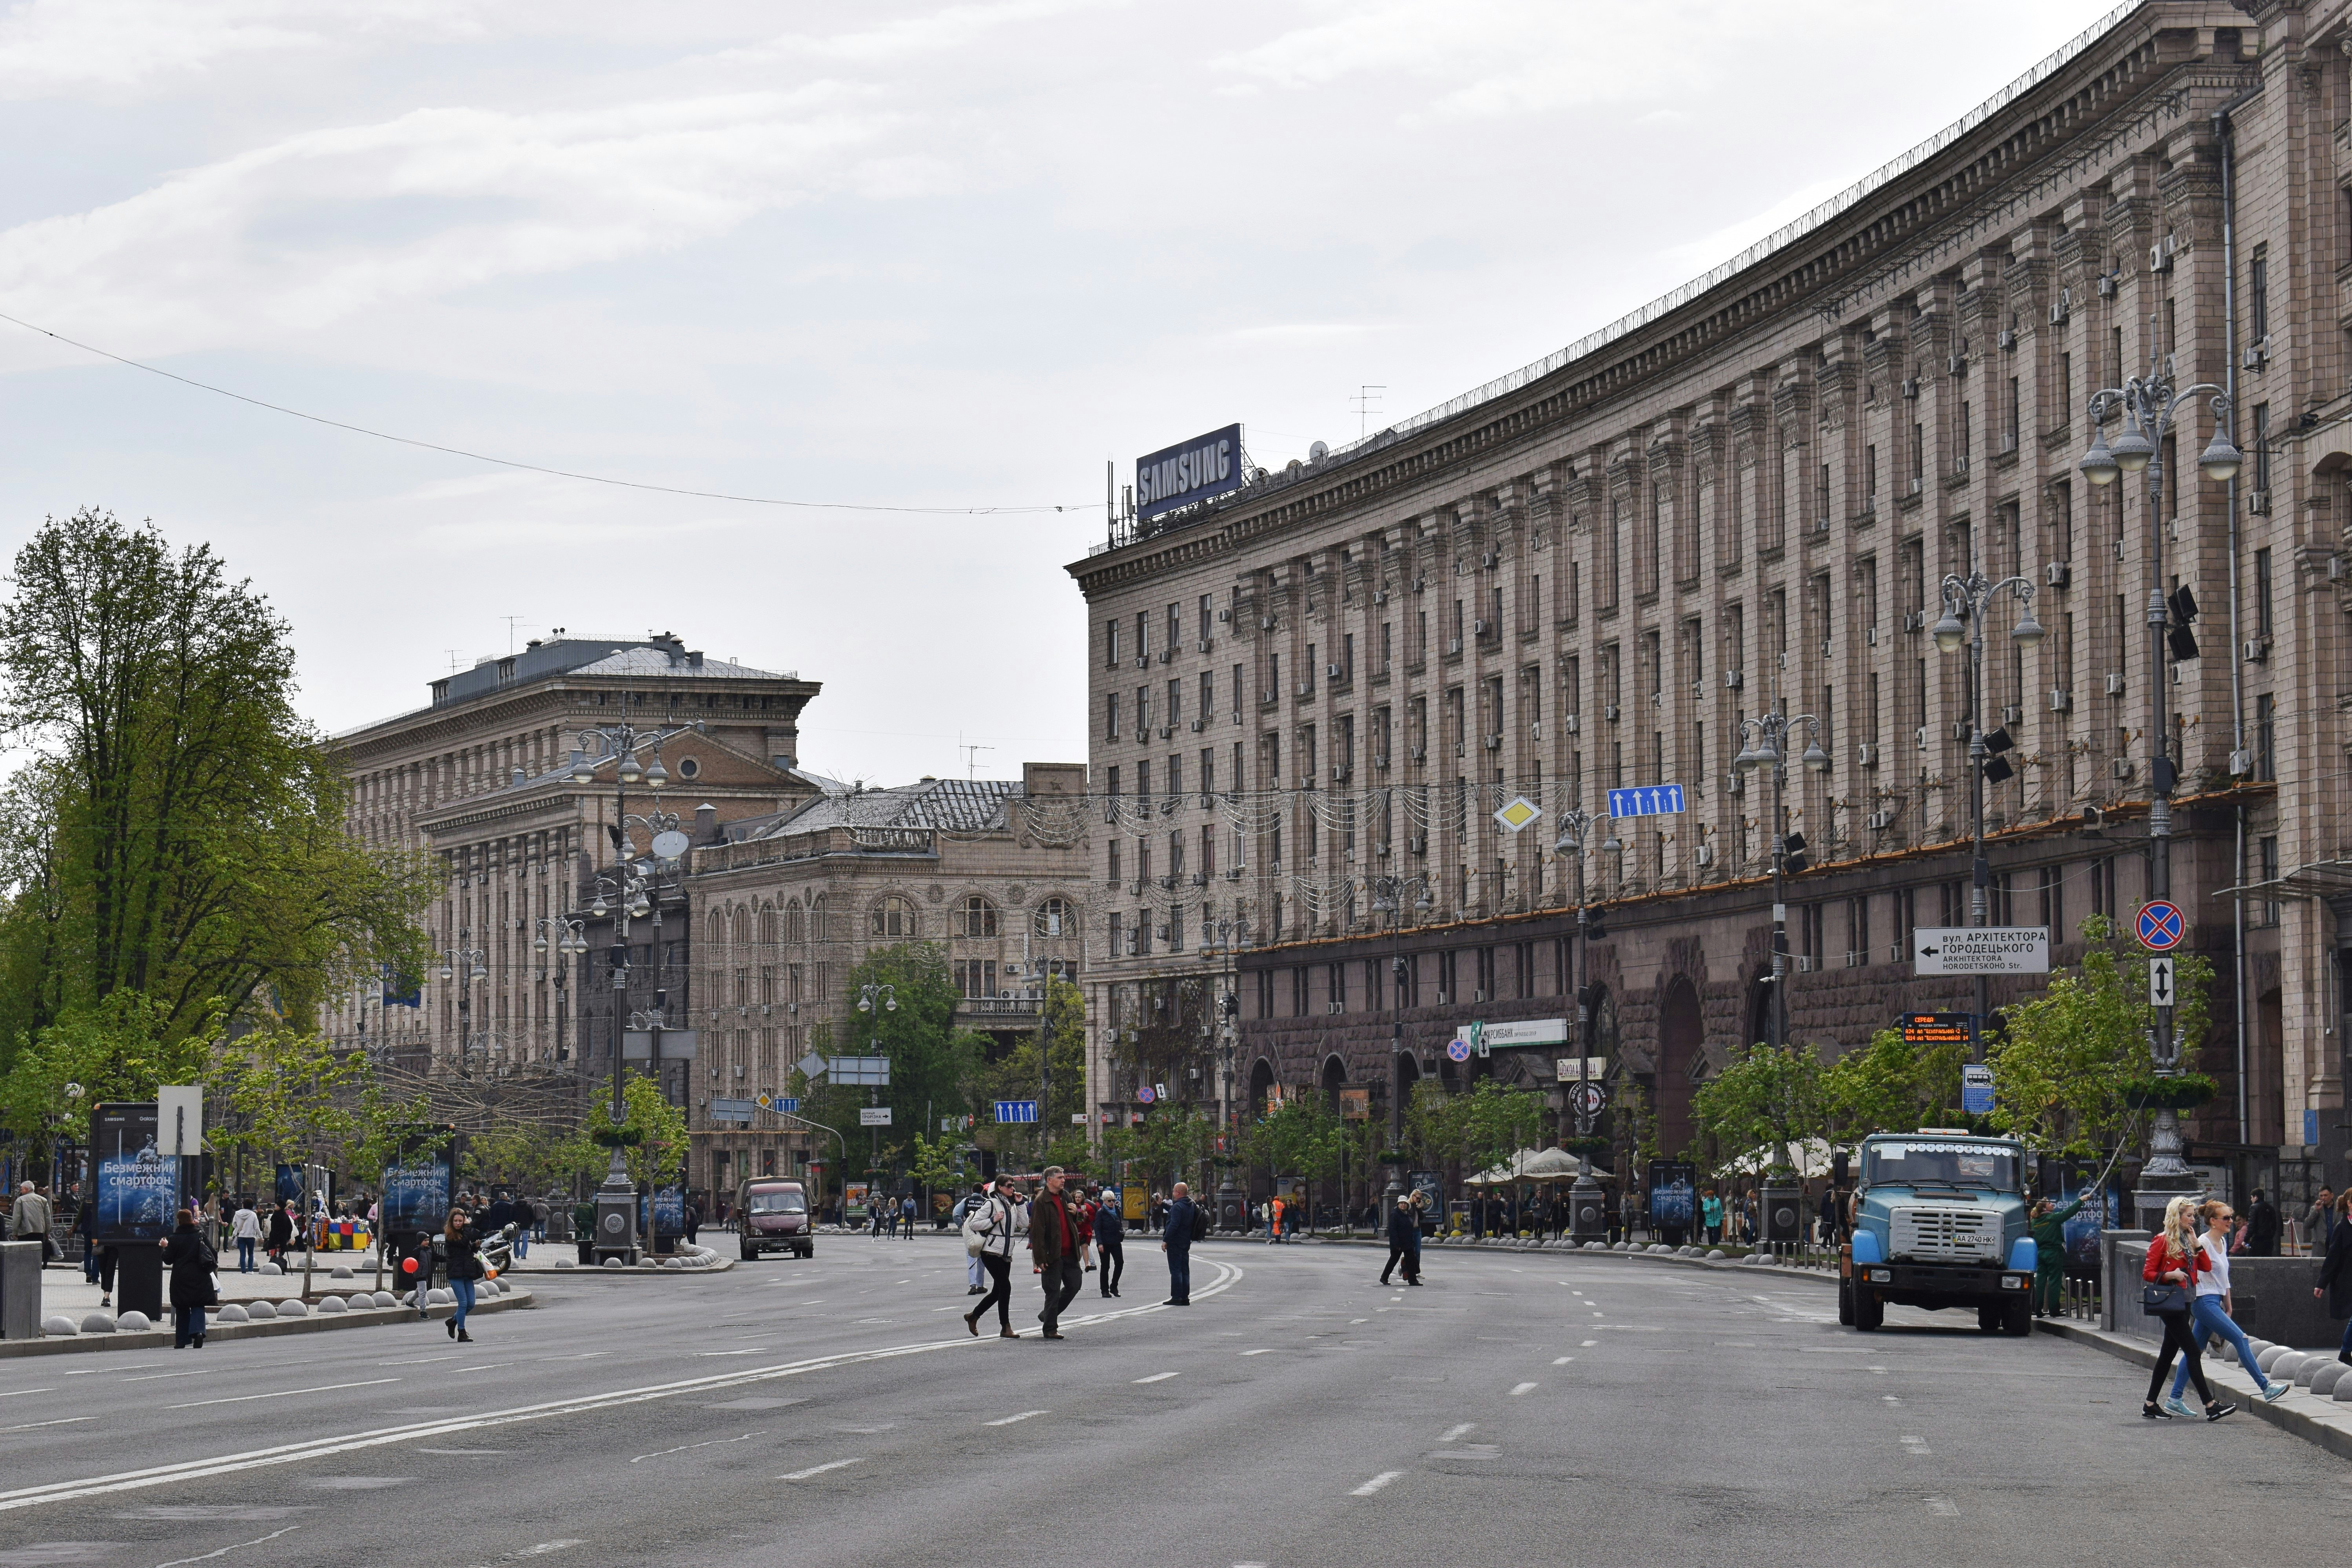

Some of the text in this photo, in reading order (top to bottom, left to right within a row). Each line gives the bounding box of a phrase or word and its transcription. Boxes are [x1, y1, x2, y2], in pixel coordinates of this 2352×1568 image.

[1139, 439, 1230, 506] SAMSUNG
[1943, 932, 2046, 944] вул. АРХІТЕКТОРА
[1943, 943, 2034, 954] ГОРОДЕЦЬКОГО
[104, 1160, 176, 1173] Безмежний
[110, 1174, 171, 1189] смартфон
[392, 1177, 441, 1189] смартфон
